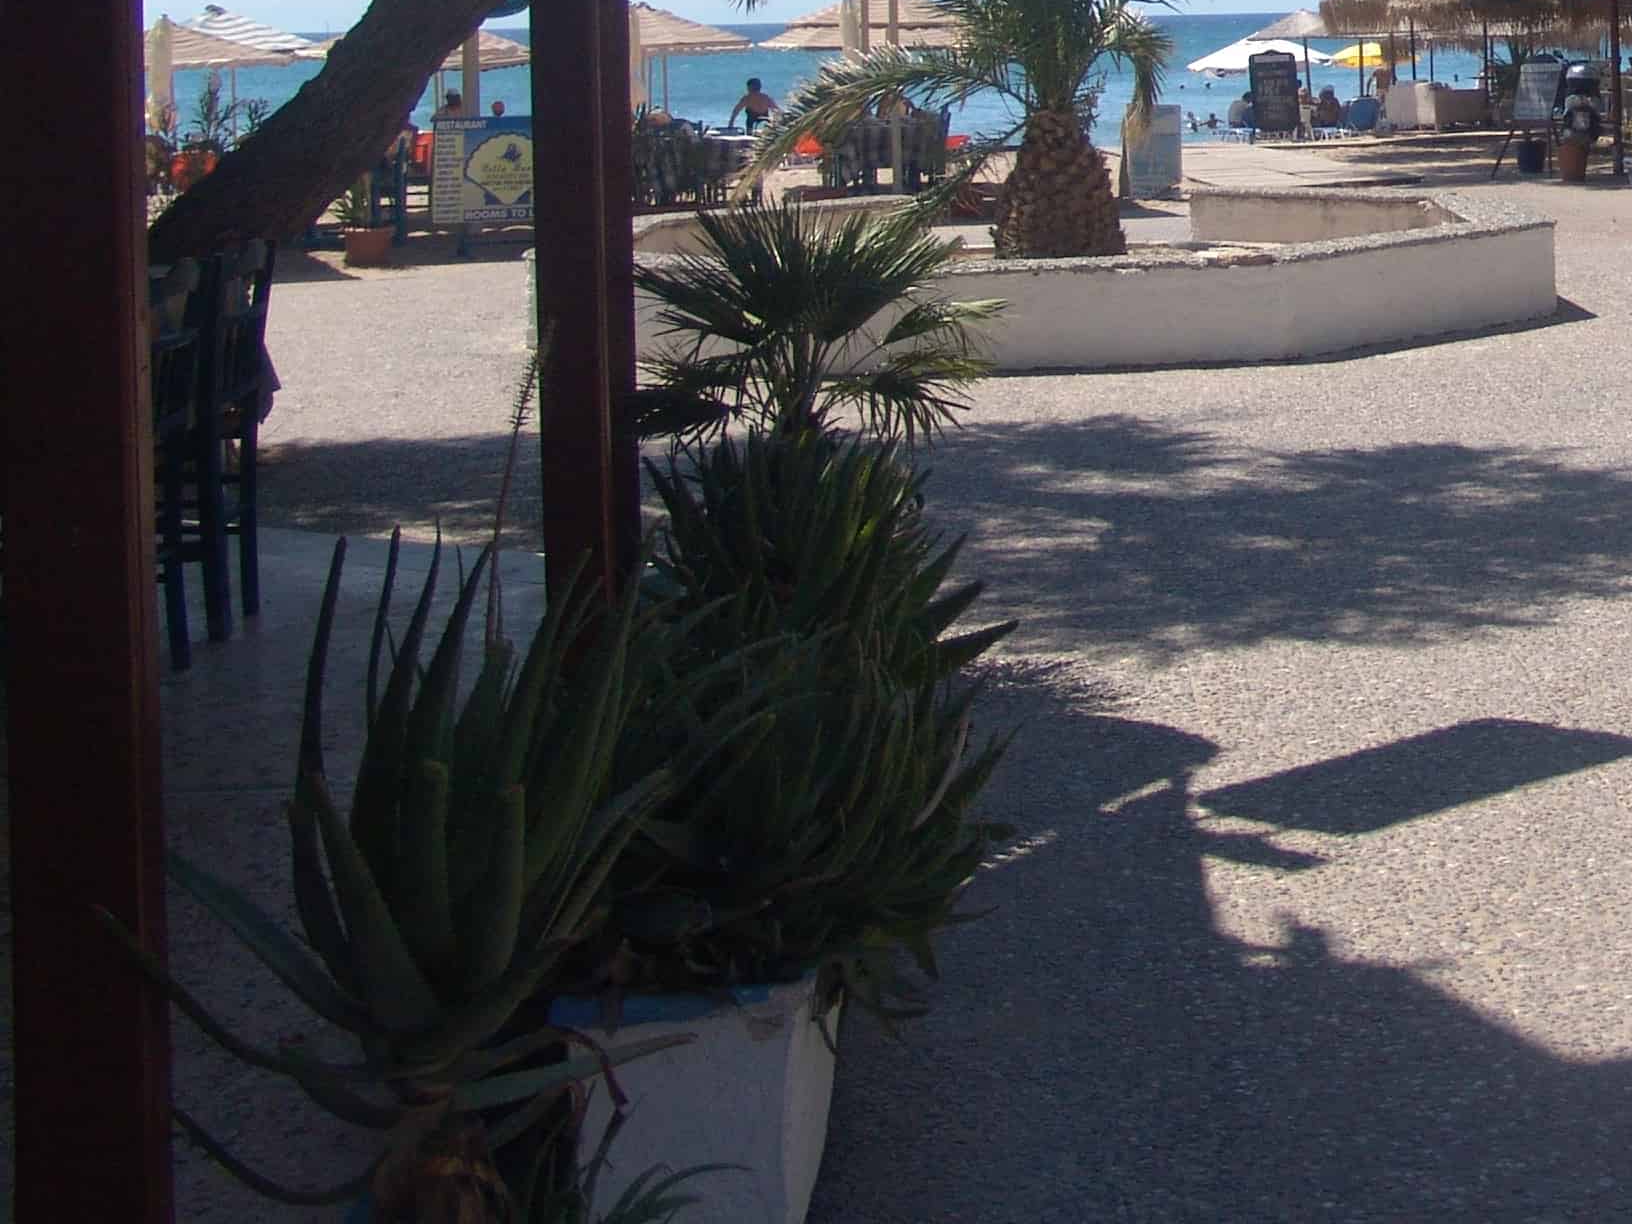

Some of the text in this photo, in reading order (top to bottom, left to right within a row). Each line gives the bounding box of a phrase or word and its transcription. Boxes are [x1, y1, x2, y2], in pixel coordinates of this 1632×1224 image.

[436, 119, 488, 129] RESTAURANT
[465, 208, 507, 220] ROOMS
[512, 207, 527, 218] TO
